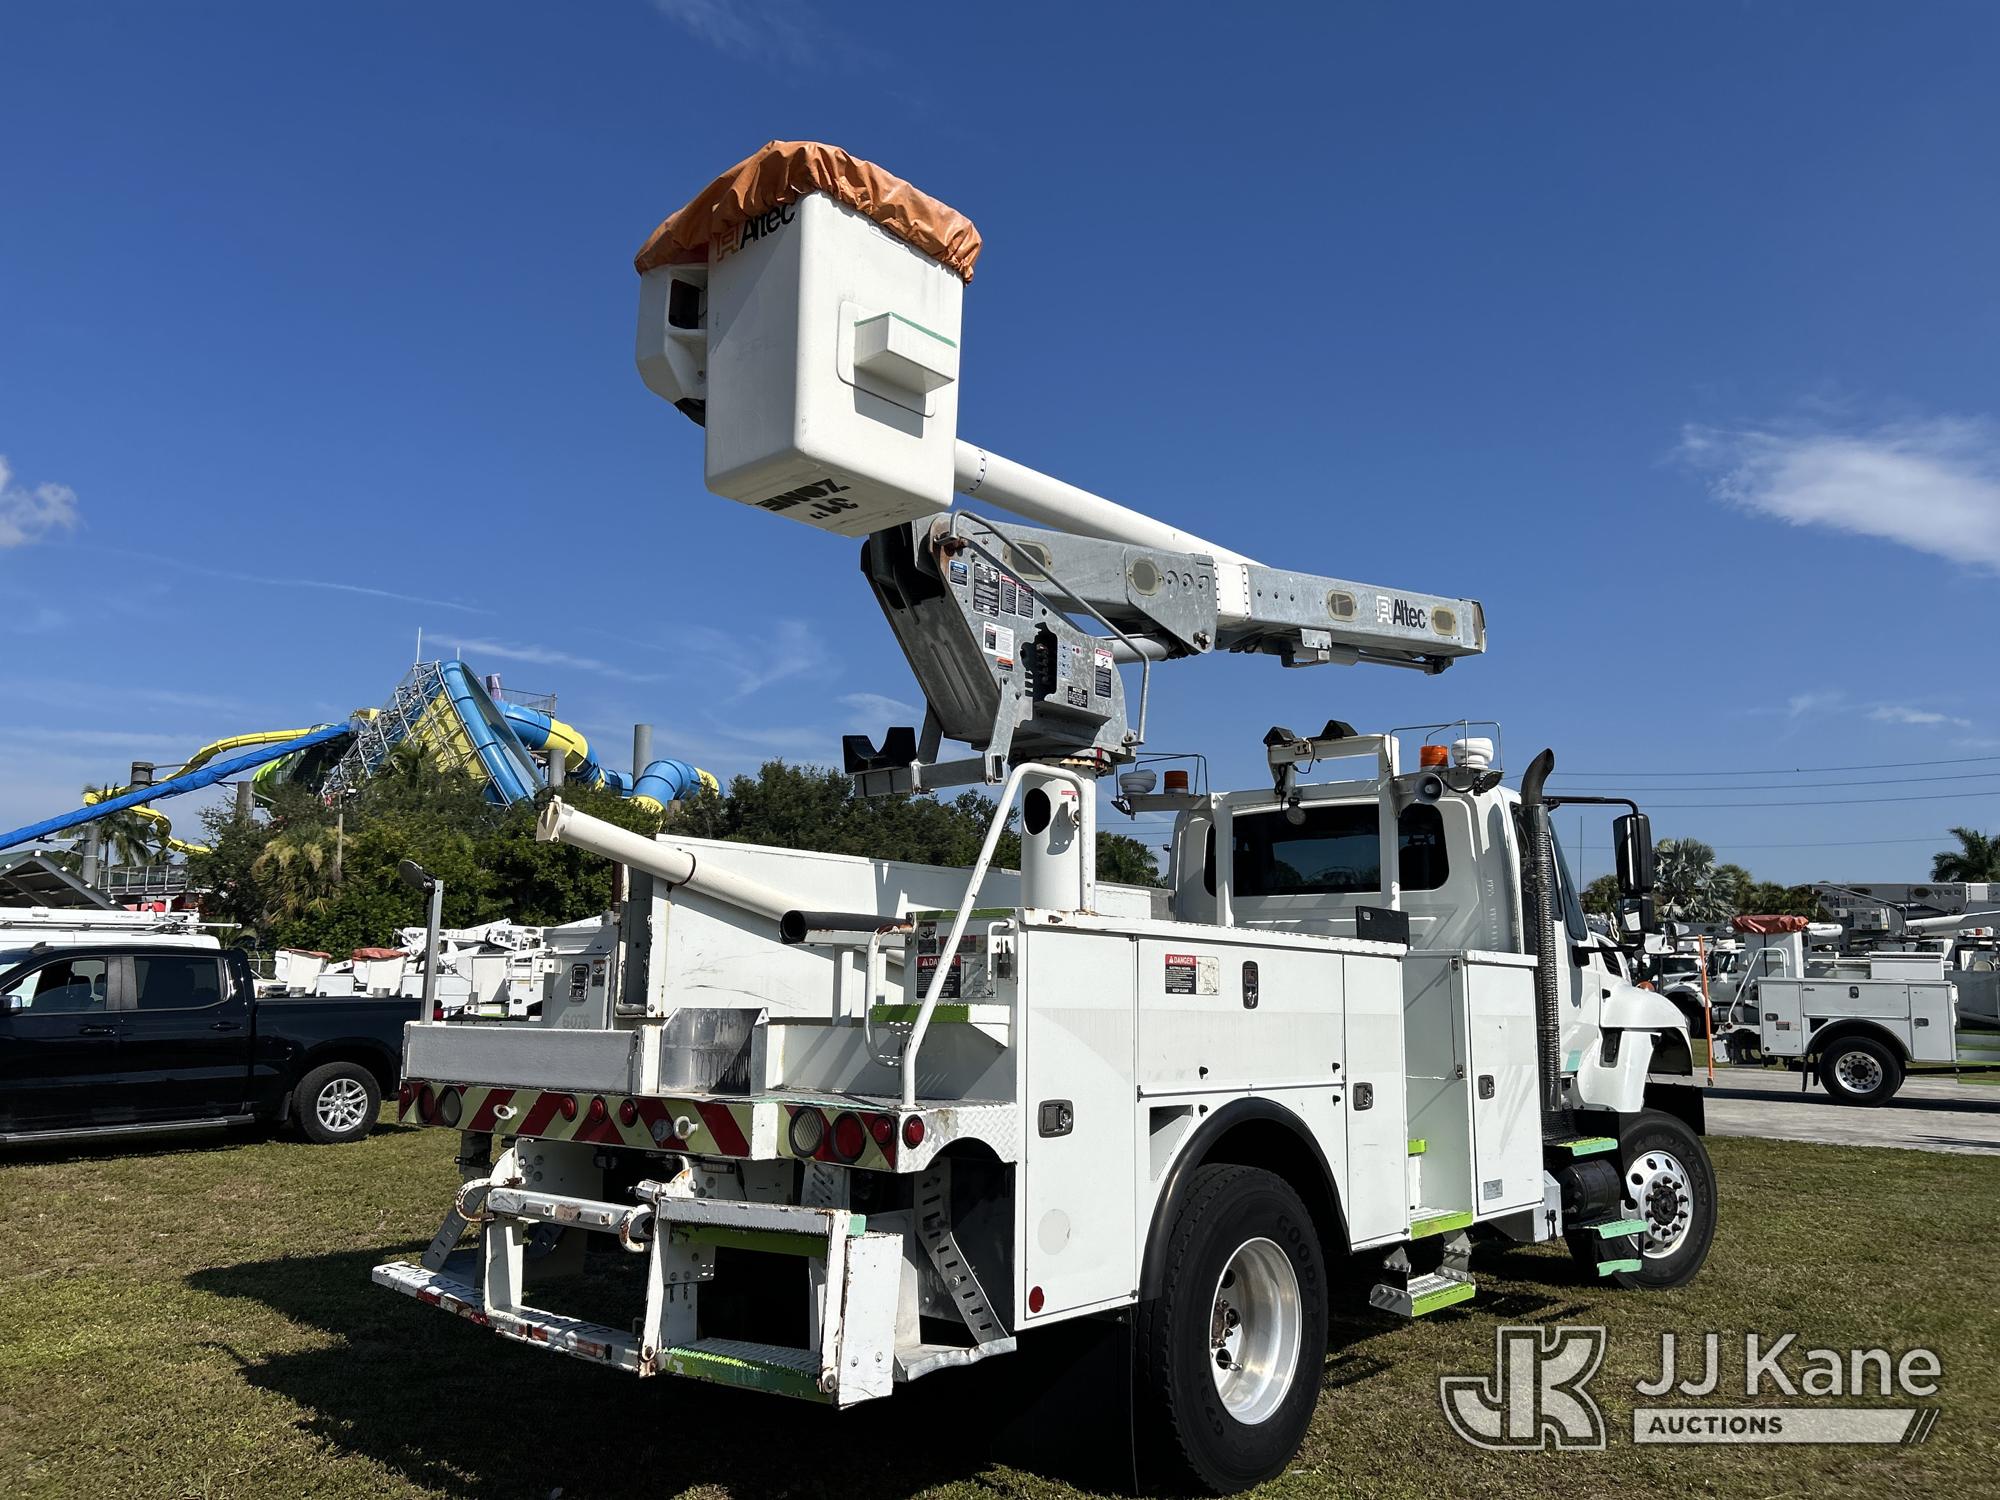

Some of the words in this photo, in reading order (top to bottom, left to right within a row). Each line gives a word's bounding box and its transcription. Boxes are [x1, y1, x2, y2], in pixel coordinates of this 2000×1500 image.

[754, 478, 851, 512] ZONE
[1392, 598, 1426, 629] Altec
[1173, 956, 1194, 965] DANGER
